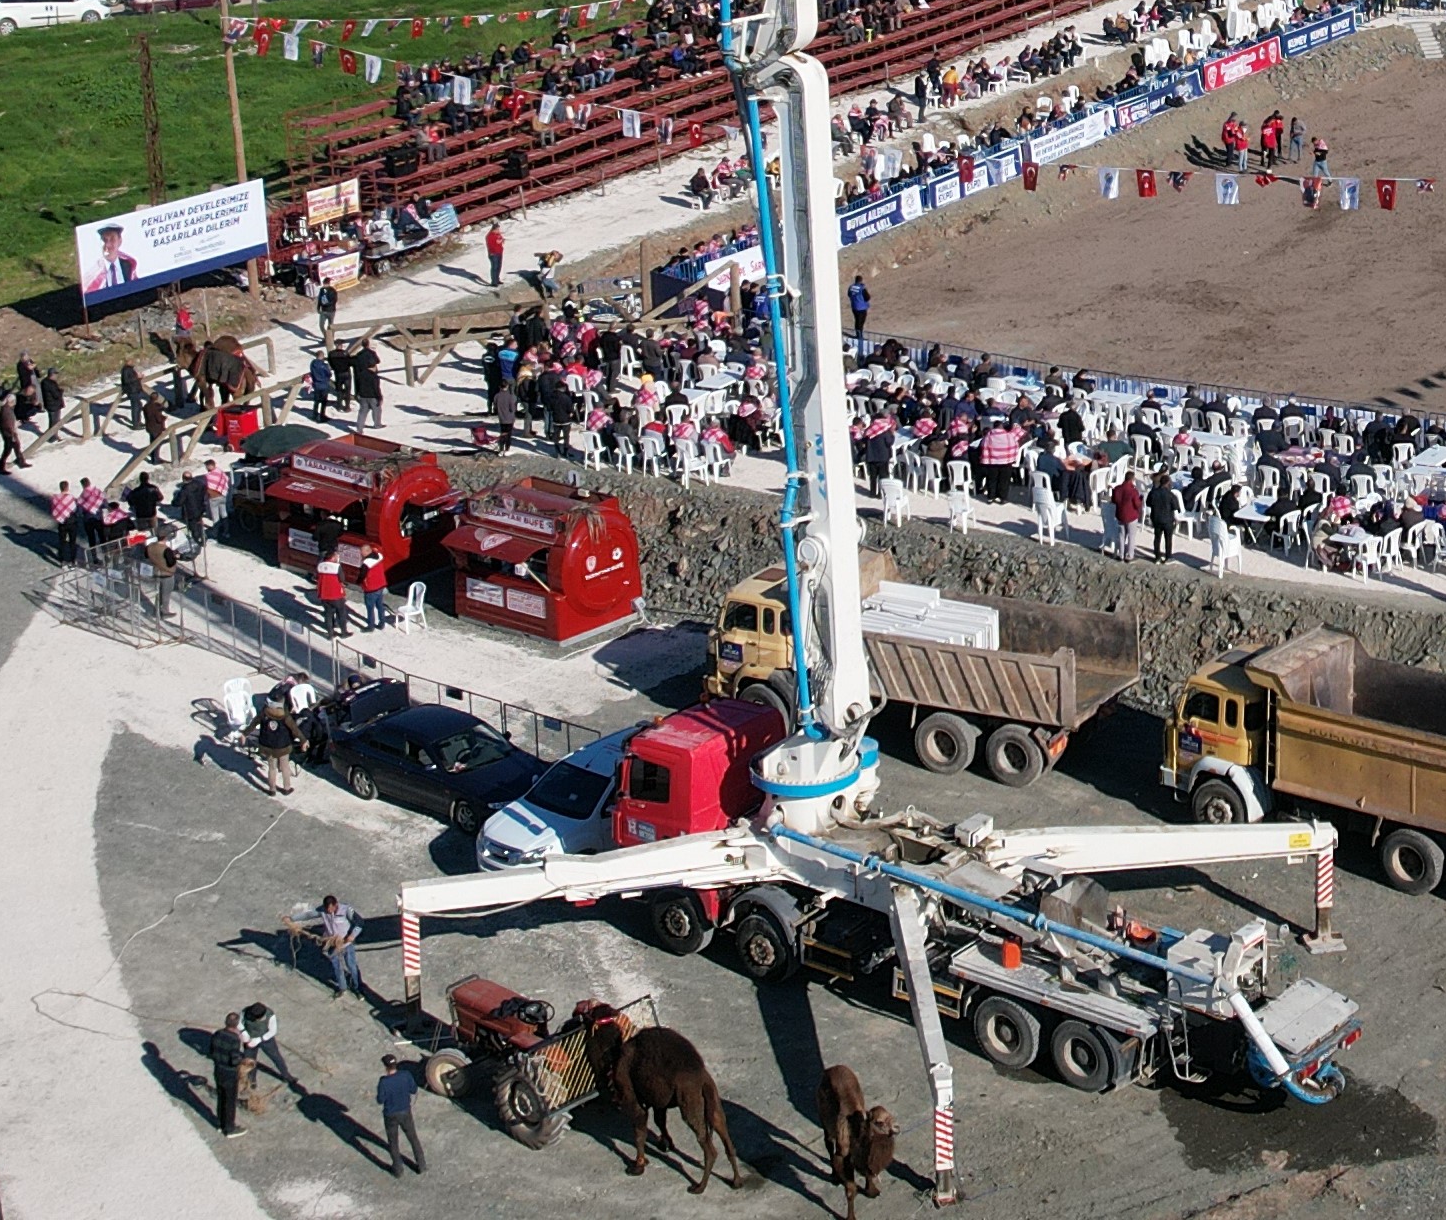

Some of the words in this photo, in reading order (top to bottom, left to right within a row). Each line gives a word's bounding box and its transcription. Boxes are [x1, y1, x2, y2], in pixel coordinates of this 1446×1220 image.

[141, 208, 185, 228] PEHLİVAN
[187, 191, 249, 216] DEVELERİMİZE
[144, 229, 155, 238] VE
[158, 221, 181, 235] DEVE
[184, 202, 248, 228] SAHİPLERİMİZE
[153, 227, 204, 248] BAŞARILAR
[205, 216, 240, 233] DİLERİM
